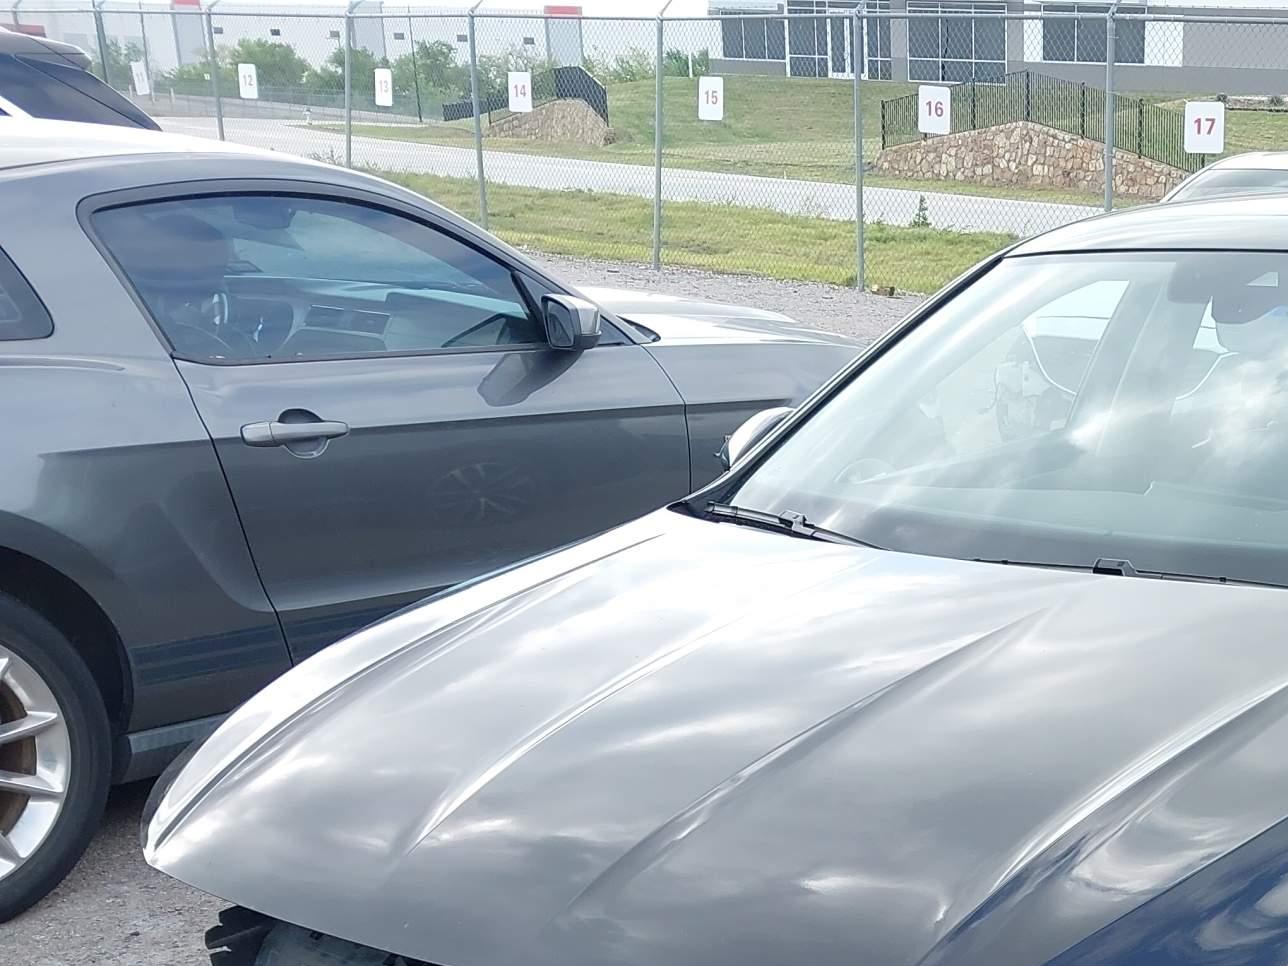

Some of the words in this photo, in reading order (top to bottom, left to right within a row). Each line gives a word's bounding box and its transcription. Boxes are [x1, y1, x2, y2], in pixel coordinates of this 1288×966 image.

[242, 74, 253, 86] 12
[378, 80, 389, 94] 13
[513, 84, 526, 98] 14
[704, 90, 718, 105] 15
[925, 101, 944, 117] 16
[1193, 117, 1216, 136] 17
